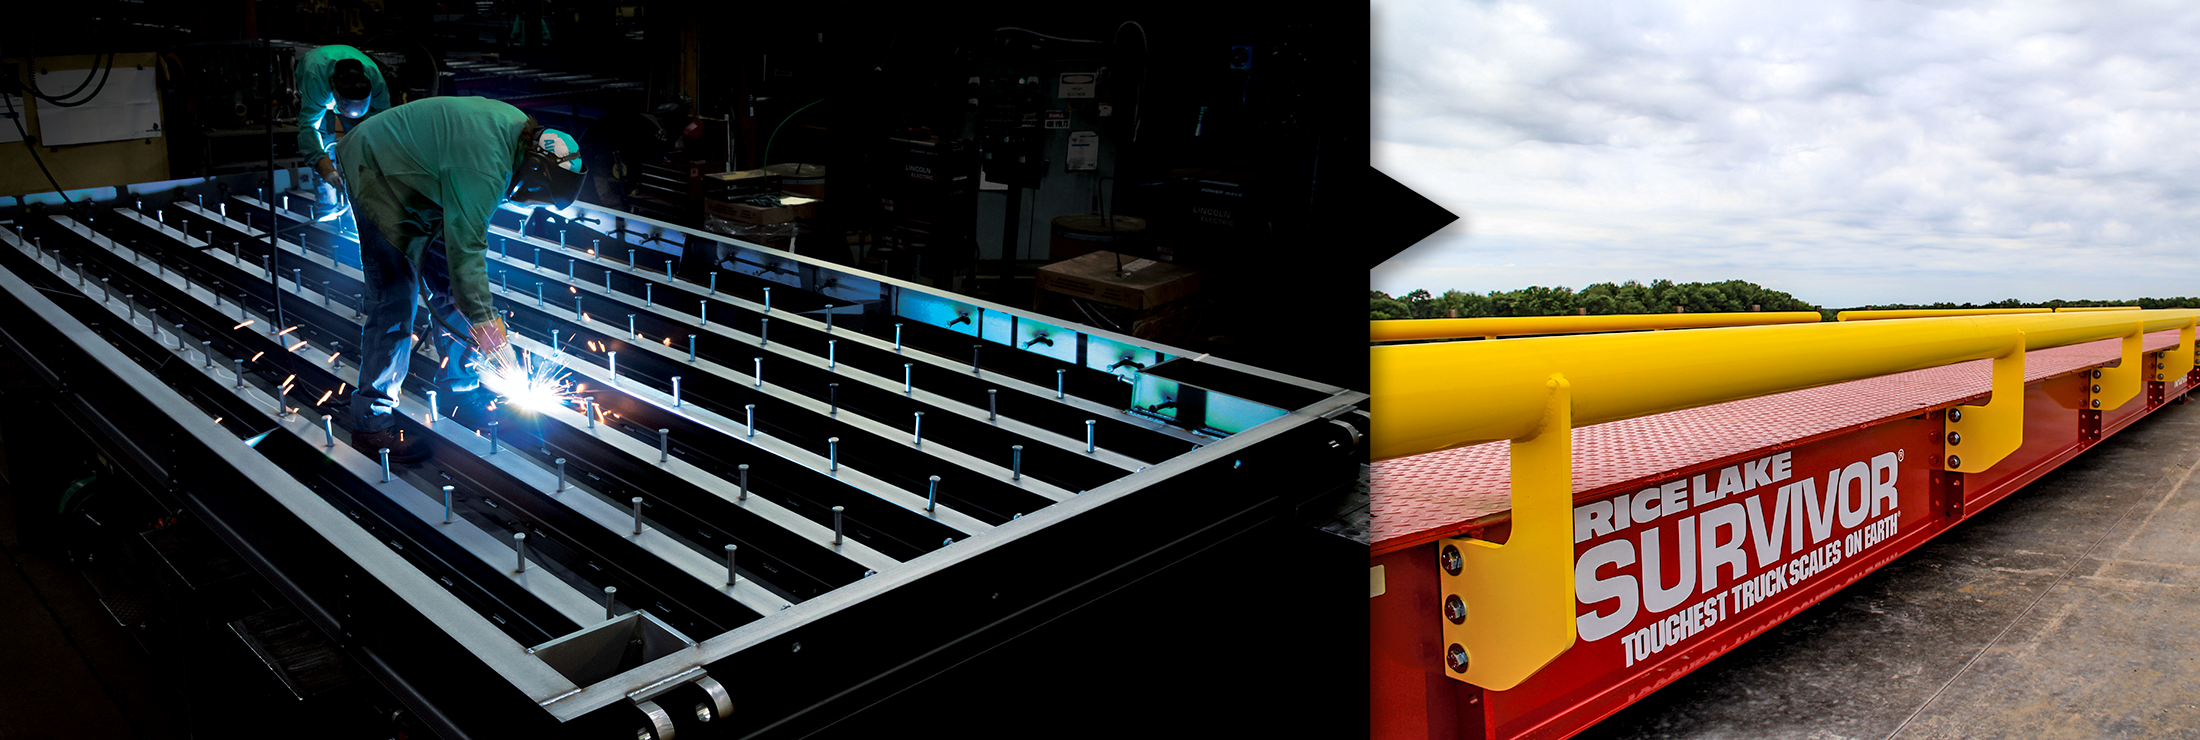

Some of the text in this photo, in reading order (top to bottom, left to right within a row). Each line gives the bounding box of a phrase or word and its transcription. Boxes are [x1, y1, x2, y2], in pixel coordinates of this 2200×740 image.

[905, 164, 931, 174] LINCOLN
[910, 172, 933, 180] ELECTRIC
[1201, 187, 1224, 195] POWER
[1193, 206, 1231, 218] LINCOLN
[1201, 216, 1234, 226] ELECTRIC
[1573, 451, 1793, 543] RICE LAKE
[1621, 590, 1728, 668] TOUGHEST
[1731, 563, 1788, 614] TRUCK
[1788, 540, 1842, 586] SCALES
[1845, 532, 1862, 558] ON
